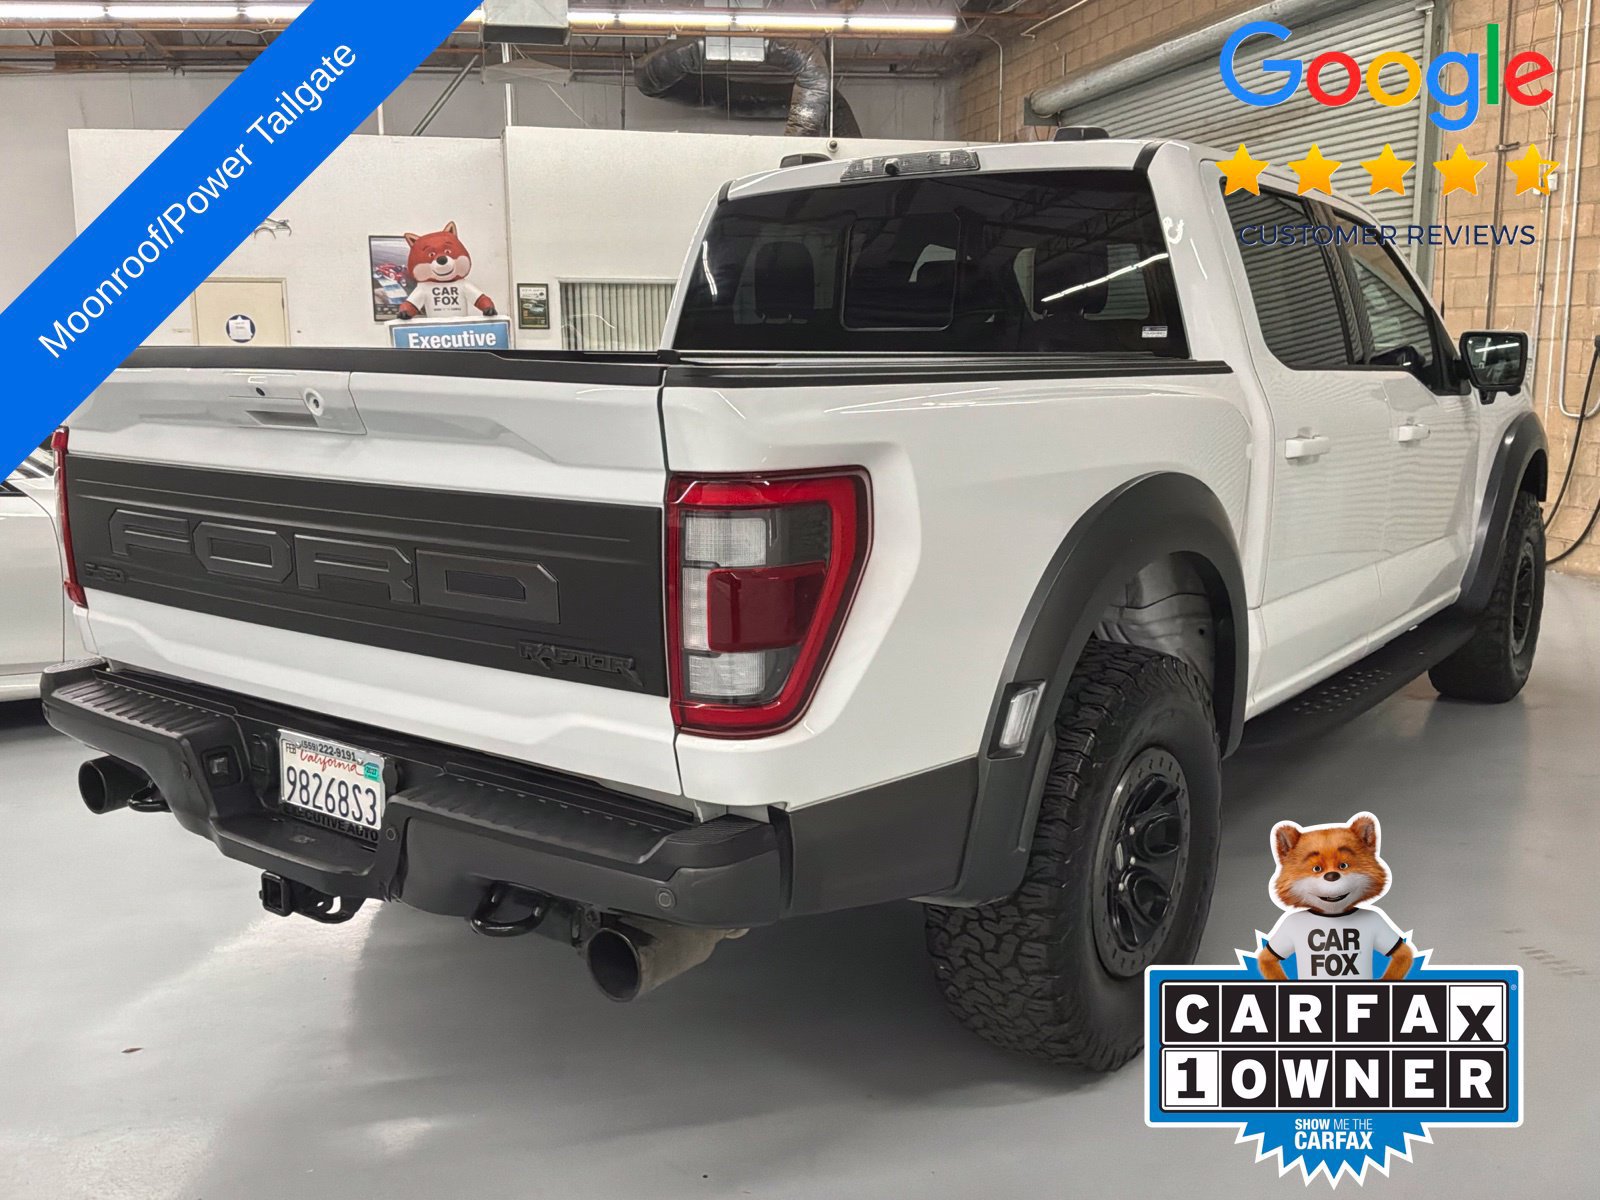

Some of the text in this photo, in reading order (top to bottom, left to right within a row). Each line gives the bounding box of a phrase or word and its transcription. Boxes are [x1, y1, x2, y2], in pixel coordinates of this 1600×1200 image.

[432, 286, 459, 296] CAR
[433, 296, 460, 306] FOX
[408, 330, 497, 349] Executive
[108, 507, 561, 625] FORD
[518, 640, 645, 687] RAPTOR
[318, 743, 357, 762] 222-9191
[299, 749, 364, 776] California
[286, 765, 378, 826] 98268S3
[346, 824, 379, 842] AUTO
